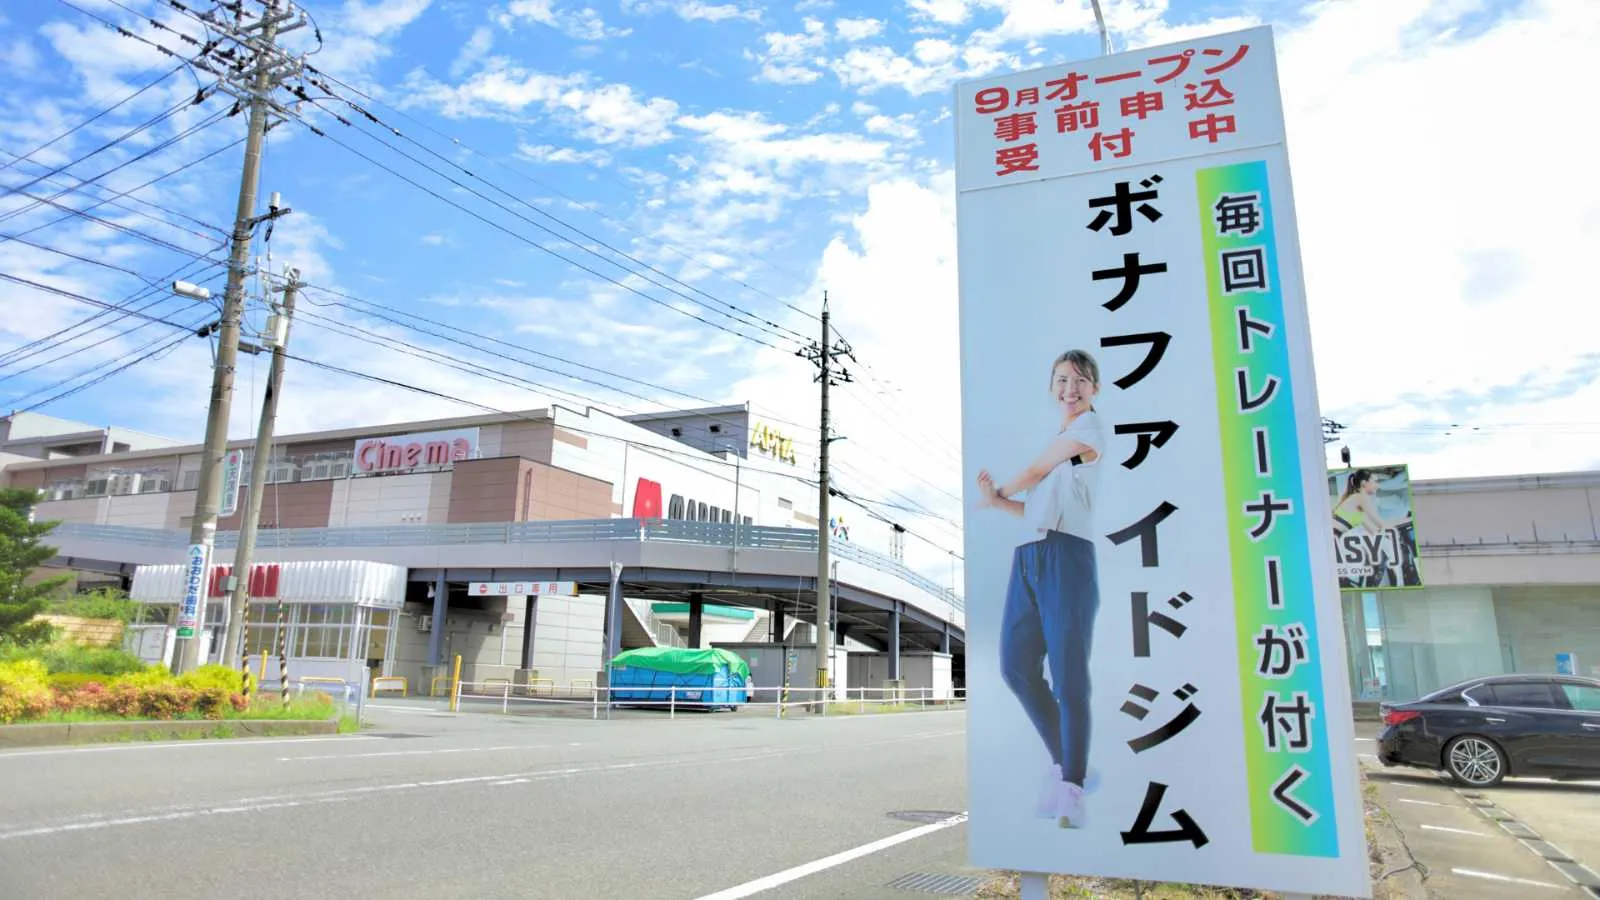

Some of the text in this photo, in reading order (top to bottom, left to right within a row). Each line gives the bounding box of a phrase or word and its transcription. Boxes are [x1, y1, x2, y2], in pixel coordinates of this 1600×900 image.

[975, 44, 1250, 114] 9月オープン
[993, 78, 1235, 142] 事前申込
[995, 113, 1237, 177] 受付中
[358, 438, 470, 472] Cinema
[1086, 174, 1210, 849] ボナファイドジム
[1214, 193, 1317, 824] 毎回トレーナーが付く
[498, 582, 558, 594] 出口専用
